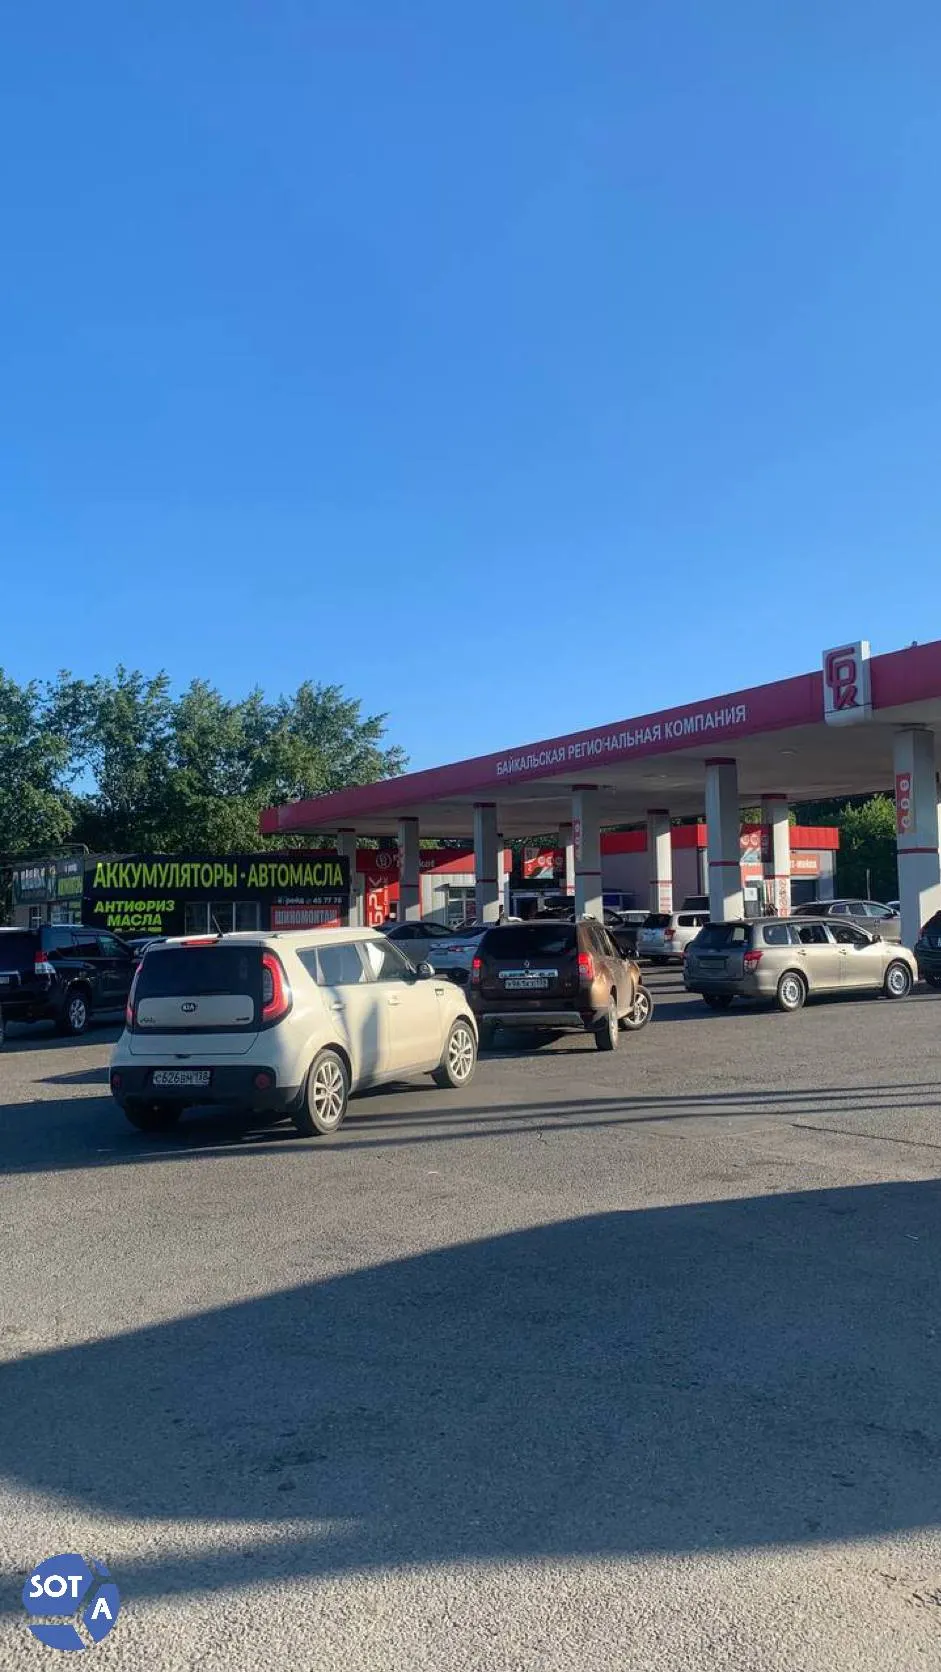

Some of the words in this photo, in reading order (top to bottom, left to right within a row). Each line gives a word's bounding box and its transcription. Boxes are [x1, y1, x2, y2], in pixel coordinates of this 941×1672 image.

[496, 747, 566, 776] БАЙКАЛЬСКАЯ
[567, 724, 662, 760] РЕГИОНАЛЬНАЯ
[664, 704, 747, 740] КОМПАНИЯ
[93, 862, 238, 889] АККУМУЛЯТОРЫ
[249, 863, 343, 888] АВТОМАСЛА
[93, 900, 175, 913] АНТИФРИЗ
[107, 913, 162, 927] МАСЛА
